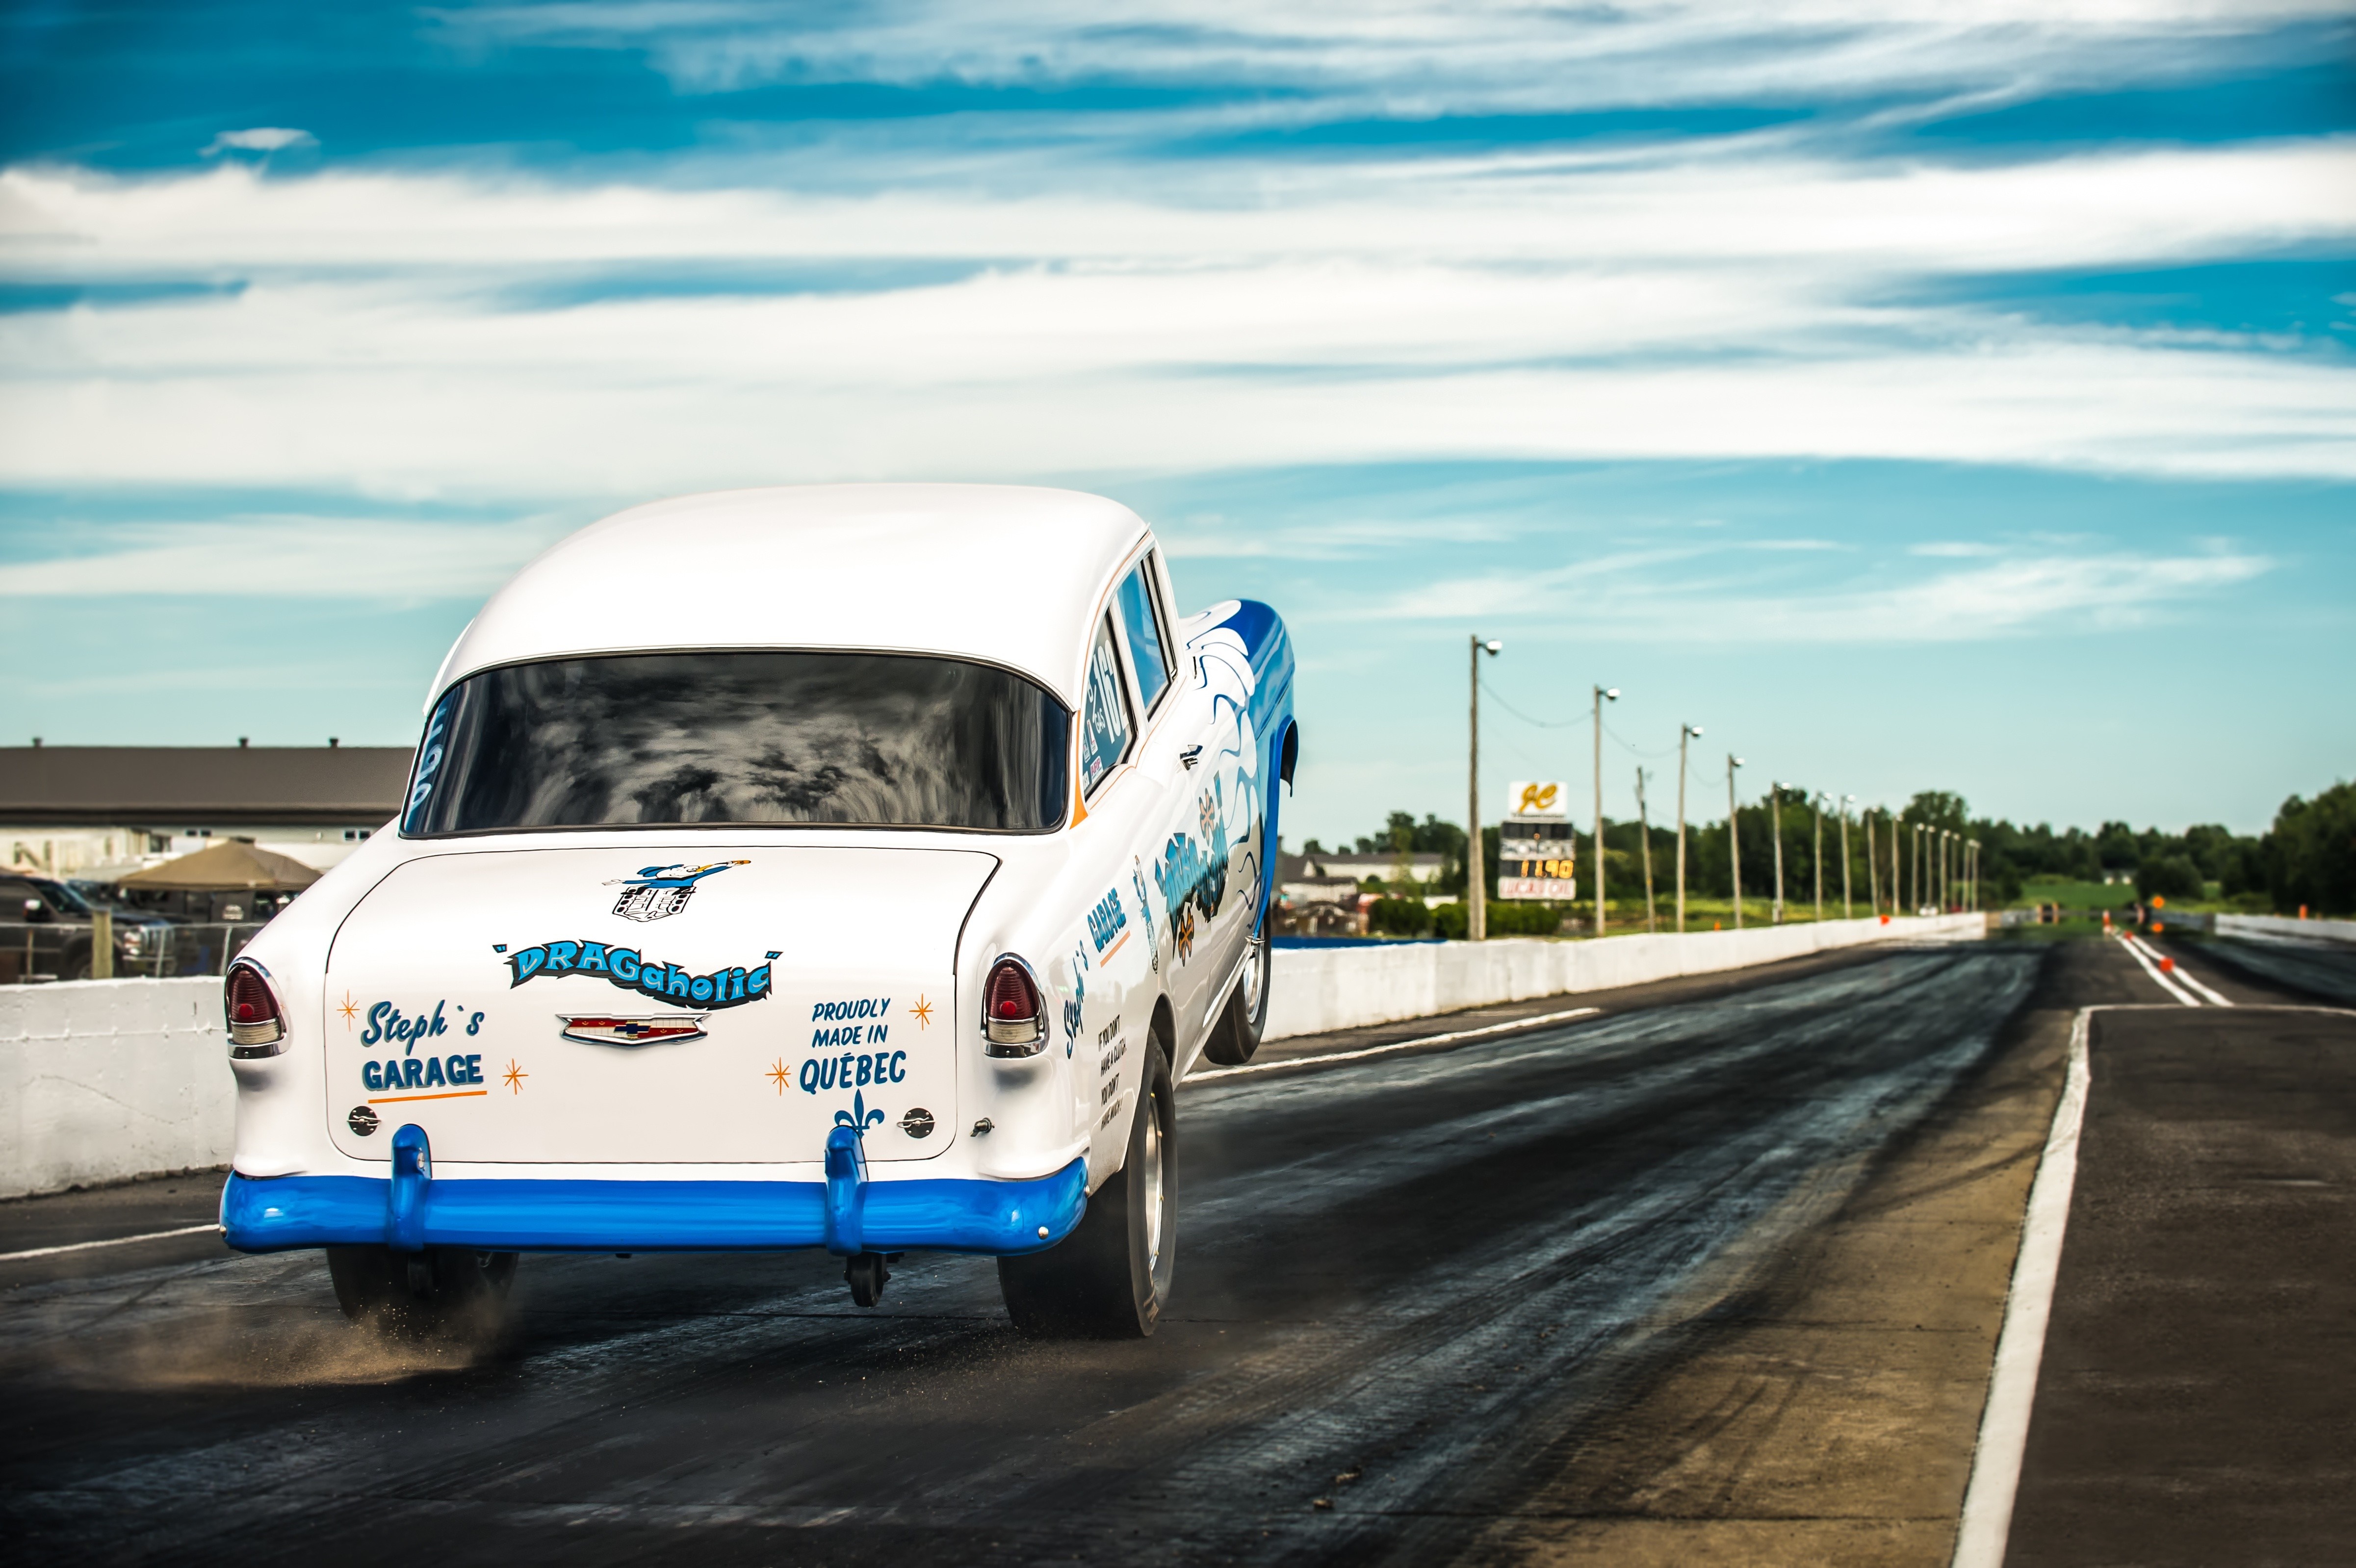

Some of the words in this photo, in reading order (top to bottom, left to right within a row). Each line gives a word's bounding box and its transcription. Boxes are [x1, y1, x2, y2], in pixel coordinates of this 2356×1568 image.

[1093, 639, 1129, 745] 162
[1094, 708, 1106, 734] GAS
[1087, 887, 1126, 953] GARAGE
[812, 998, 891, 1022] PROUDLY
[812, 1026, 863, 1048] MADE
[867, 1024, 888, 1044] IN
[1098, 1031, 1102, 1052] IF
[362, 1054, 484, 1091] GARAGE
[800, 1050, 906, 1095] QUÉBEC
[1100, 1051, 1110, 1077] HAVE
[1110, 1050, 1113, 1067] A
